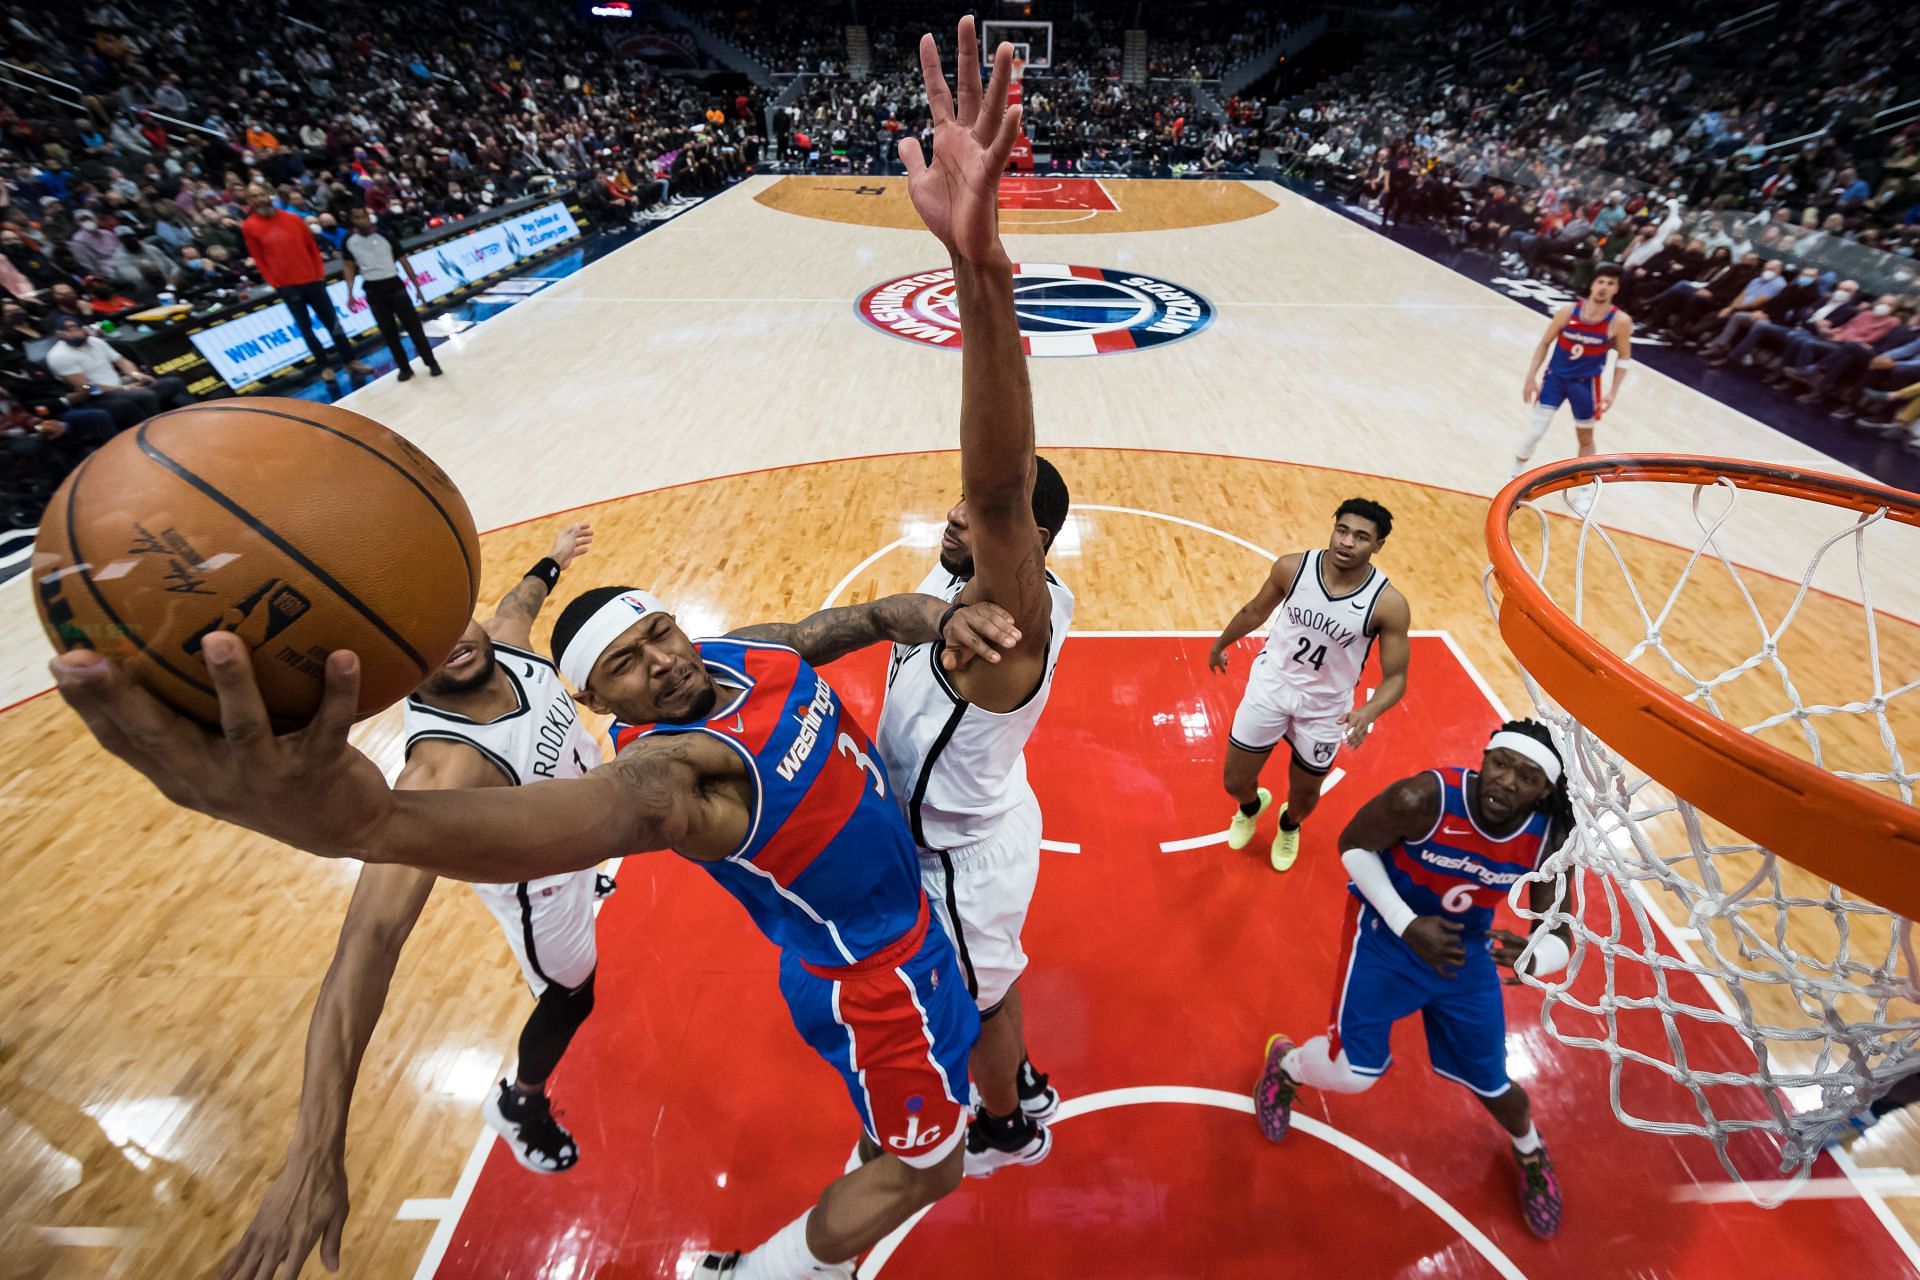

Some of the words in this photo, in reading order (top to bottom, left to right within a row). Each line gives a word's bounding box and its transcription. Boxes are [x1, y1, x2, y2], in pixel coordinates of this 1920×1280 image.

[1120, 277, 1201, 335] WIZARDS
[225, 339, 264, 364] WIN
[259, 328, 288, 350] THE
[1569, 344, 1584, 360] 9
[1287, 606, 1359, 649] BROOKLYN
[1292, 636, 1329, 671] 24
[533, 689, 577, 778] ROOKLY
[837, 732, 886, 798] 3
[1442, 884, 1481, 913] 6
[888, 1115, 941, 1150] dc
